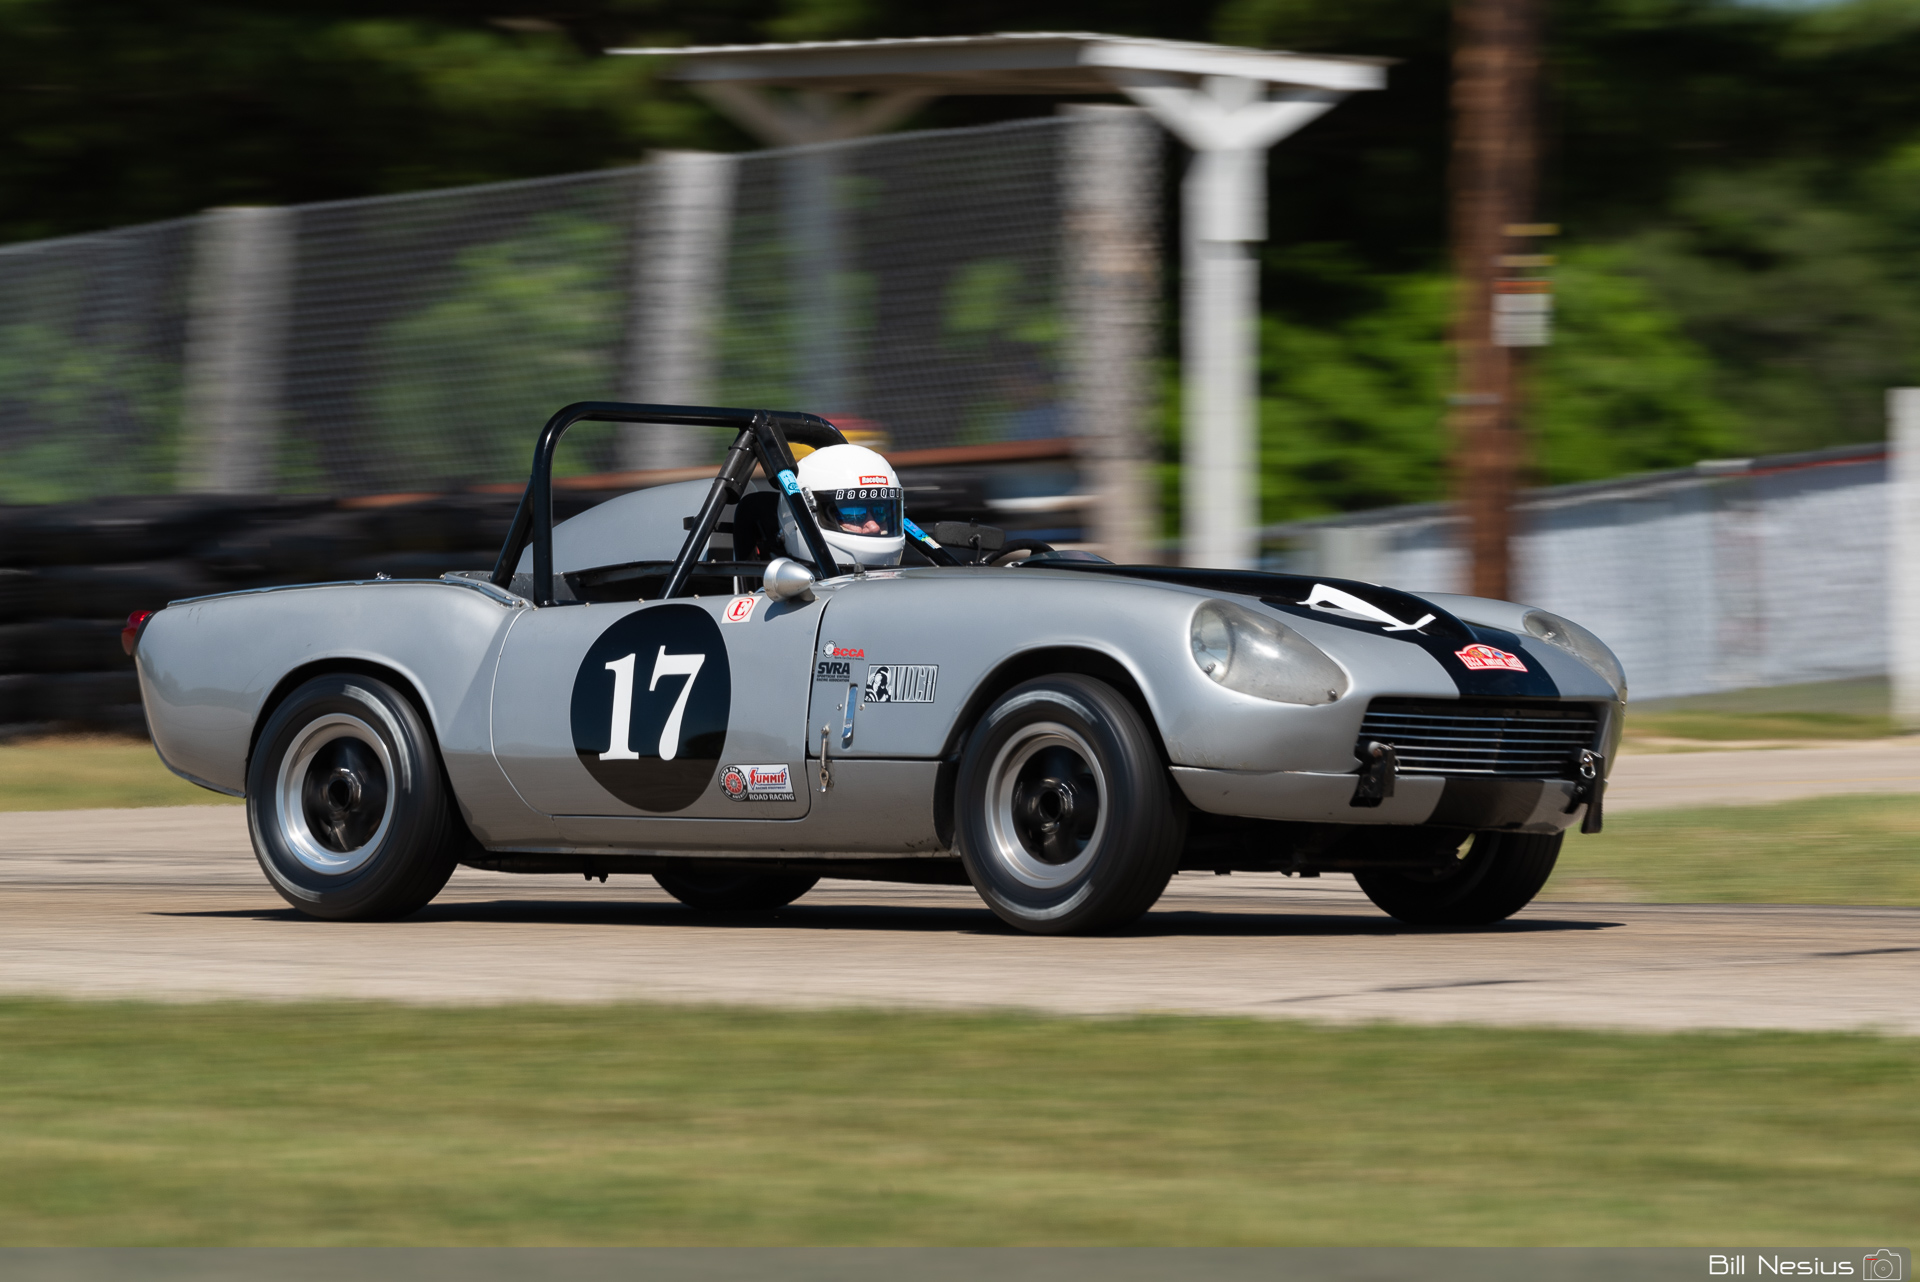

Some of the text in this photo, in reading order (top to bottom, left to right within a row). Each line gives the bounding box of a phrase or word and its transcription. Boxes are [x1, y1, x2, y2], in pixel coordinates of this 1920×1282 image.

[835, 488, 904, 500] RaceQui
[732, 600, 749, 617] E
[832, 647, 865, 658] SCCA
[817, 661, 851, 675] SVRA
[599, 645, 706, 761] 17
[749, 767, 787, 790] SUMMIT
[748, 793, 795, 801] ROAD RACING
